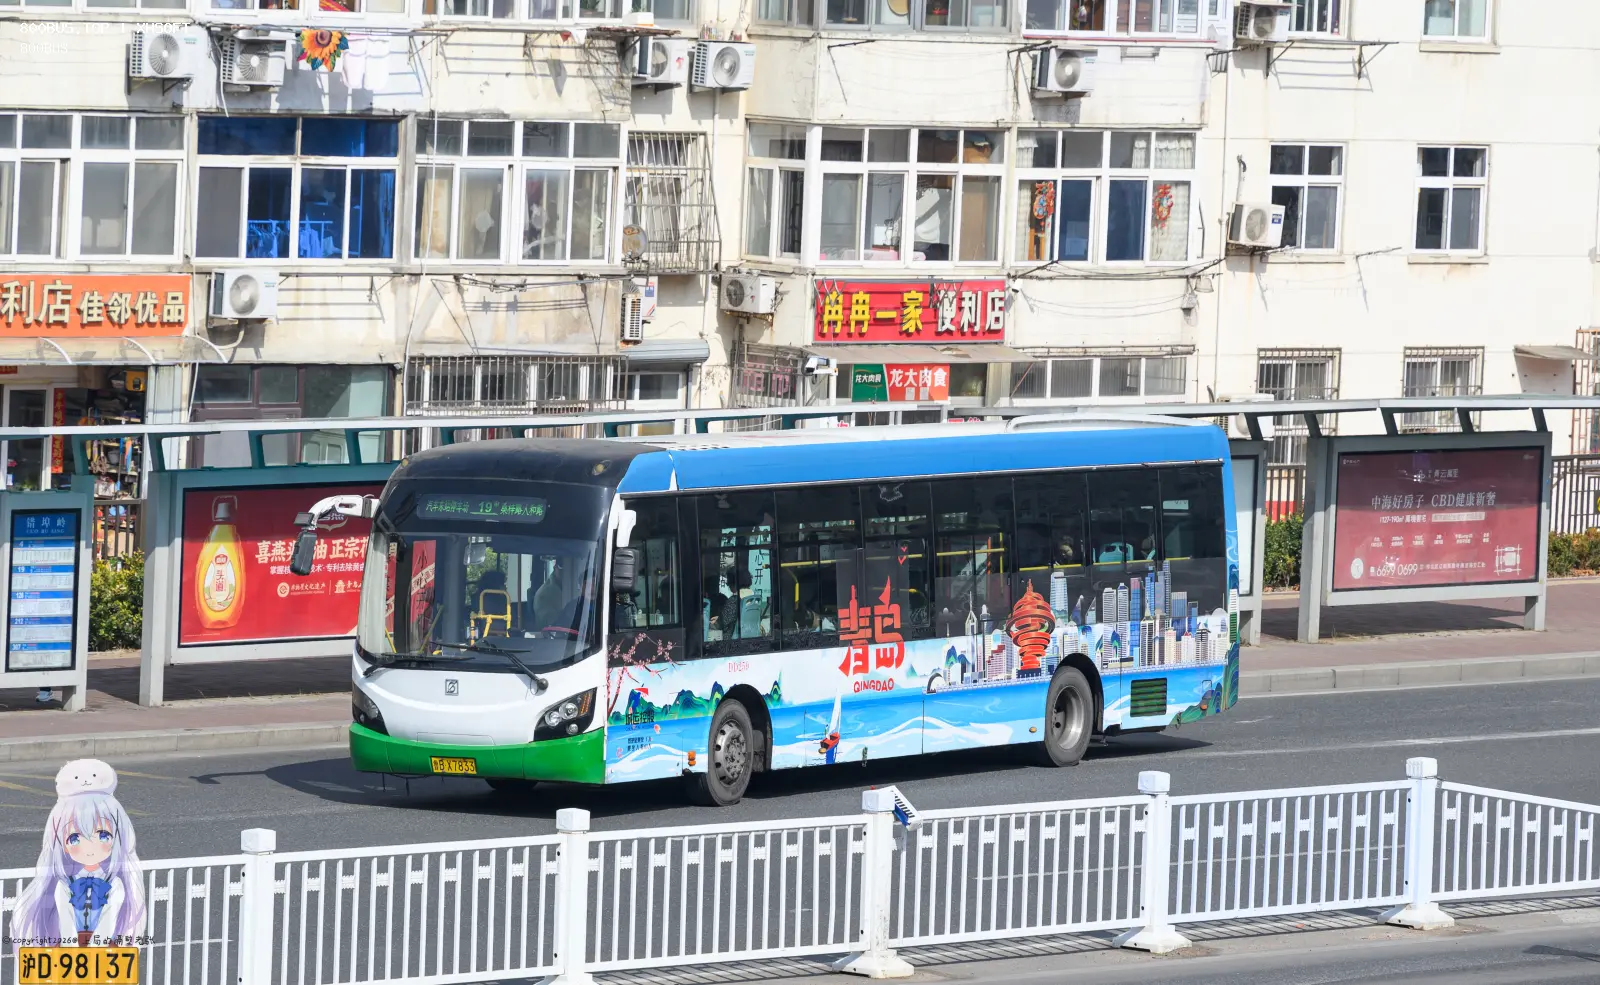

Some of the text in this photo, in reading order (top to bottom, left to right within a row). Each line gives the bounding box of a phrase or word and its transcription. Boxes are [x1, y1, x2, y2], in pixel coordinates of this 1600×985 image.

[78, 291, 186, 325] 佳邻优品
[889, 367, 948, 388] 龙大肉食
[1371, 493, 1425, 510] 中海好房子
[1397, 564, 1418, 576] 0699
[837, 575, 905, 677] 青岛
[853, 677, 895, 694] QINGDAO
